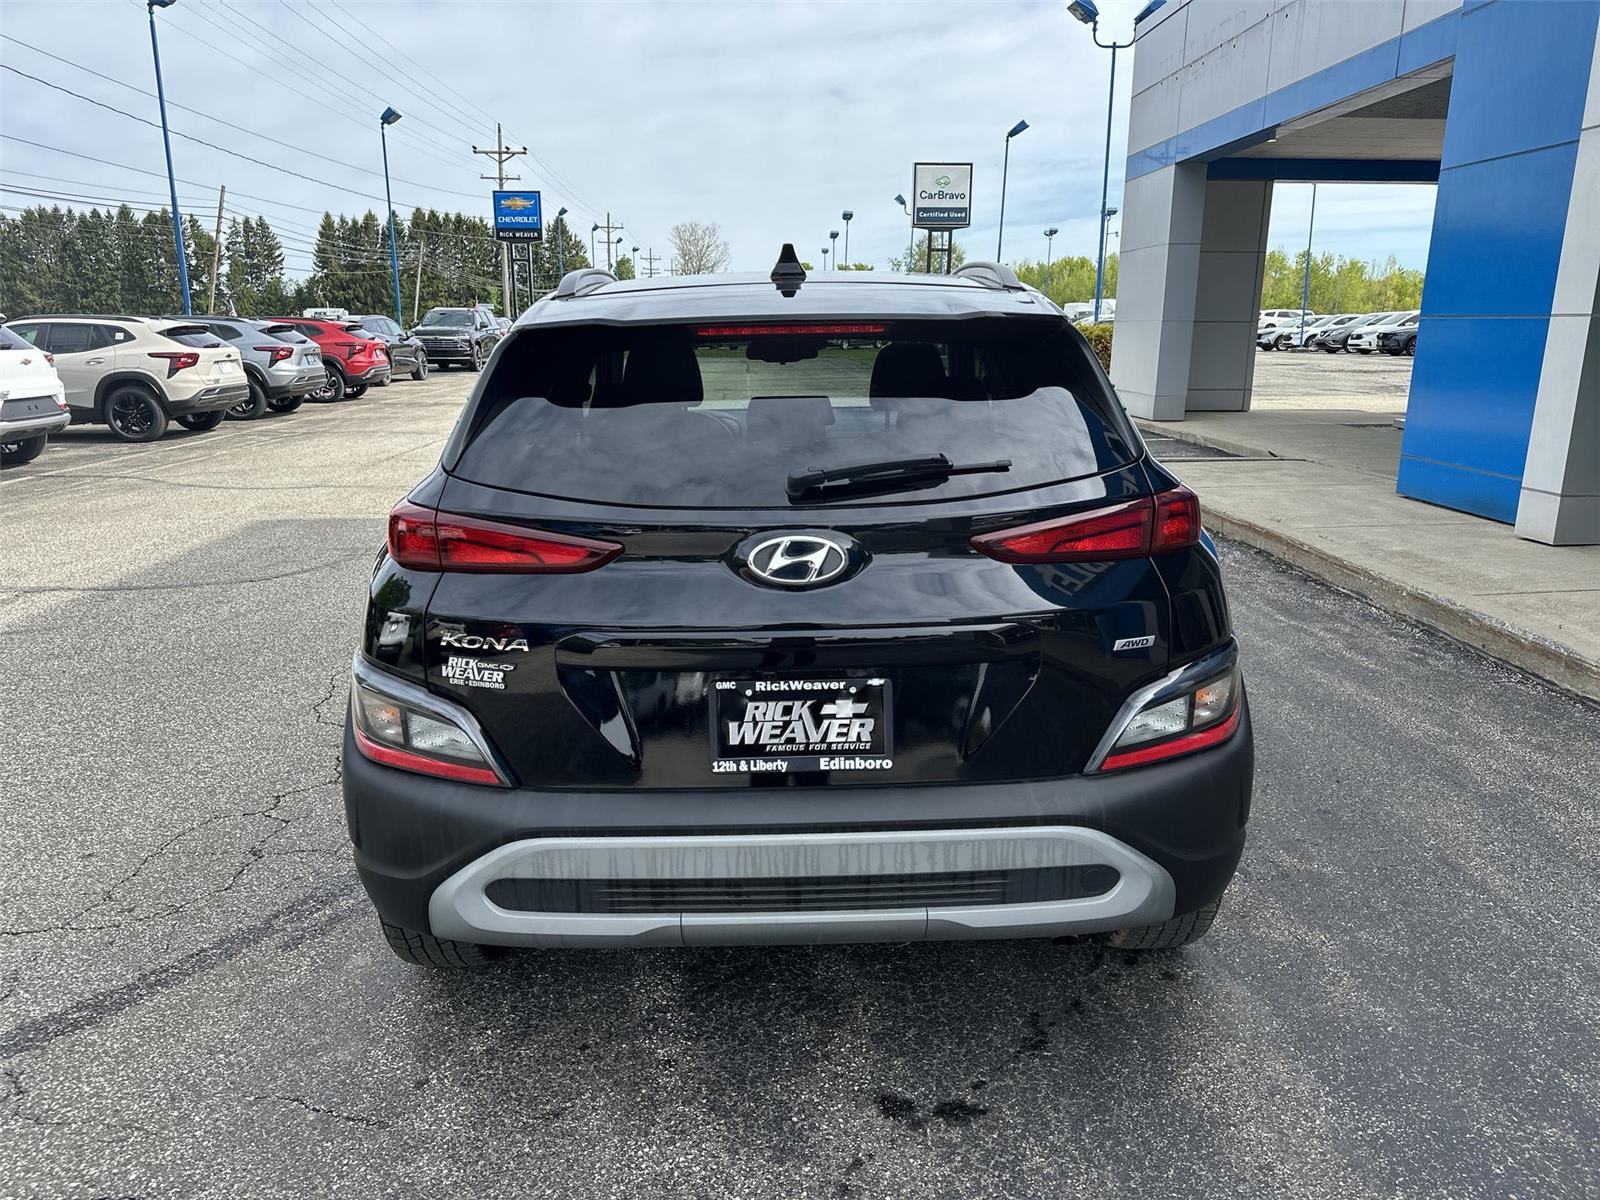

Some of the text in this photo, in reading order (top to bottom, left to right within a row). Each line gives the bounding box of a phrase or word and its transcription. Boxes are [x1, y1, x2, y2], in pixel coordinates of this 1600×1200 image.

[919, 190, 966, 200] CarBravo
[440, 631, 530, 652] KONA
[1120, 638, 1150, 648] AWD
[447, 656, 478, 669] RICK
[477, 662, 499, 670] GMC
[441, 665, 504, 683] WEAVER
[449, 678, 505, 690] ERIE EDINBORO
[715, 682, 737, 690] GMC
[755, 680, 847, 692] RickWeaver
[744, 699, 817, 722] RICK
[728, 718, 875, 746] WEAVER
[766, 742, 871, 752] FAMOUS FOR SERVICE
[712, 759, 788, 773] 12th & Liberty
[819, 757, 893, 770] Edinboro
